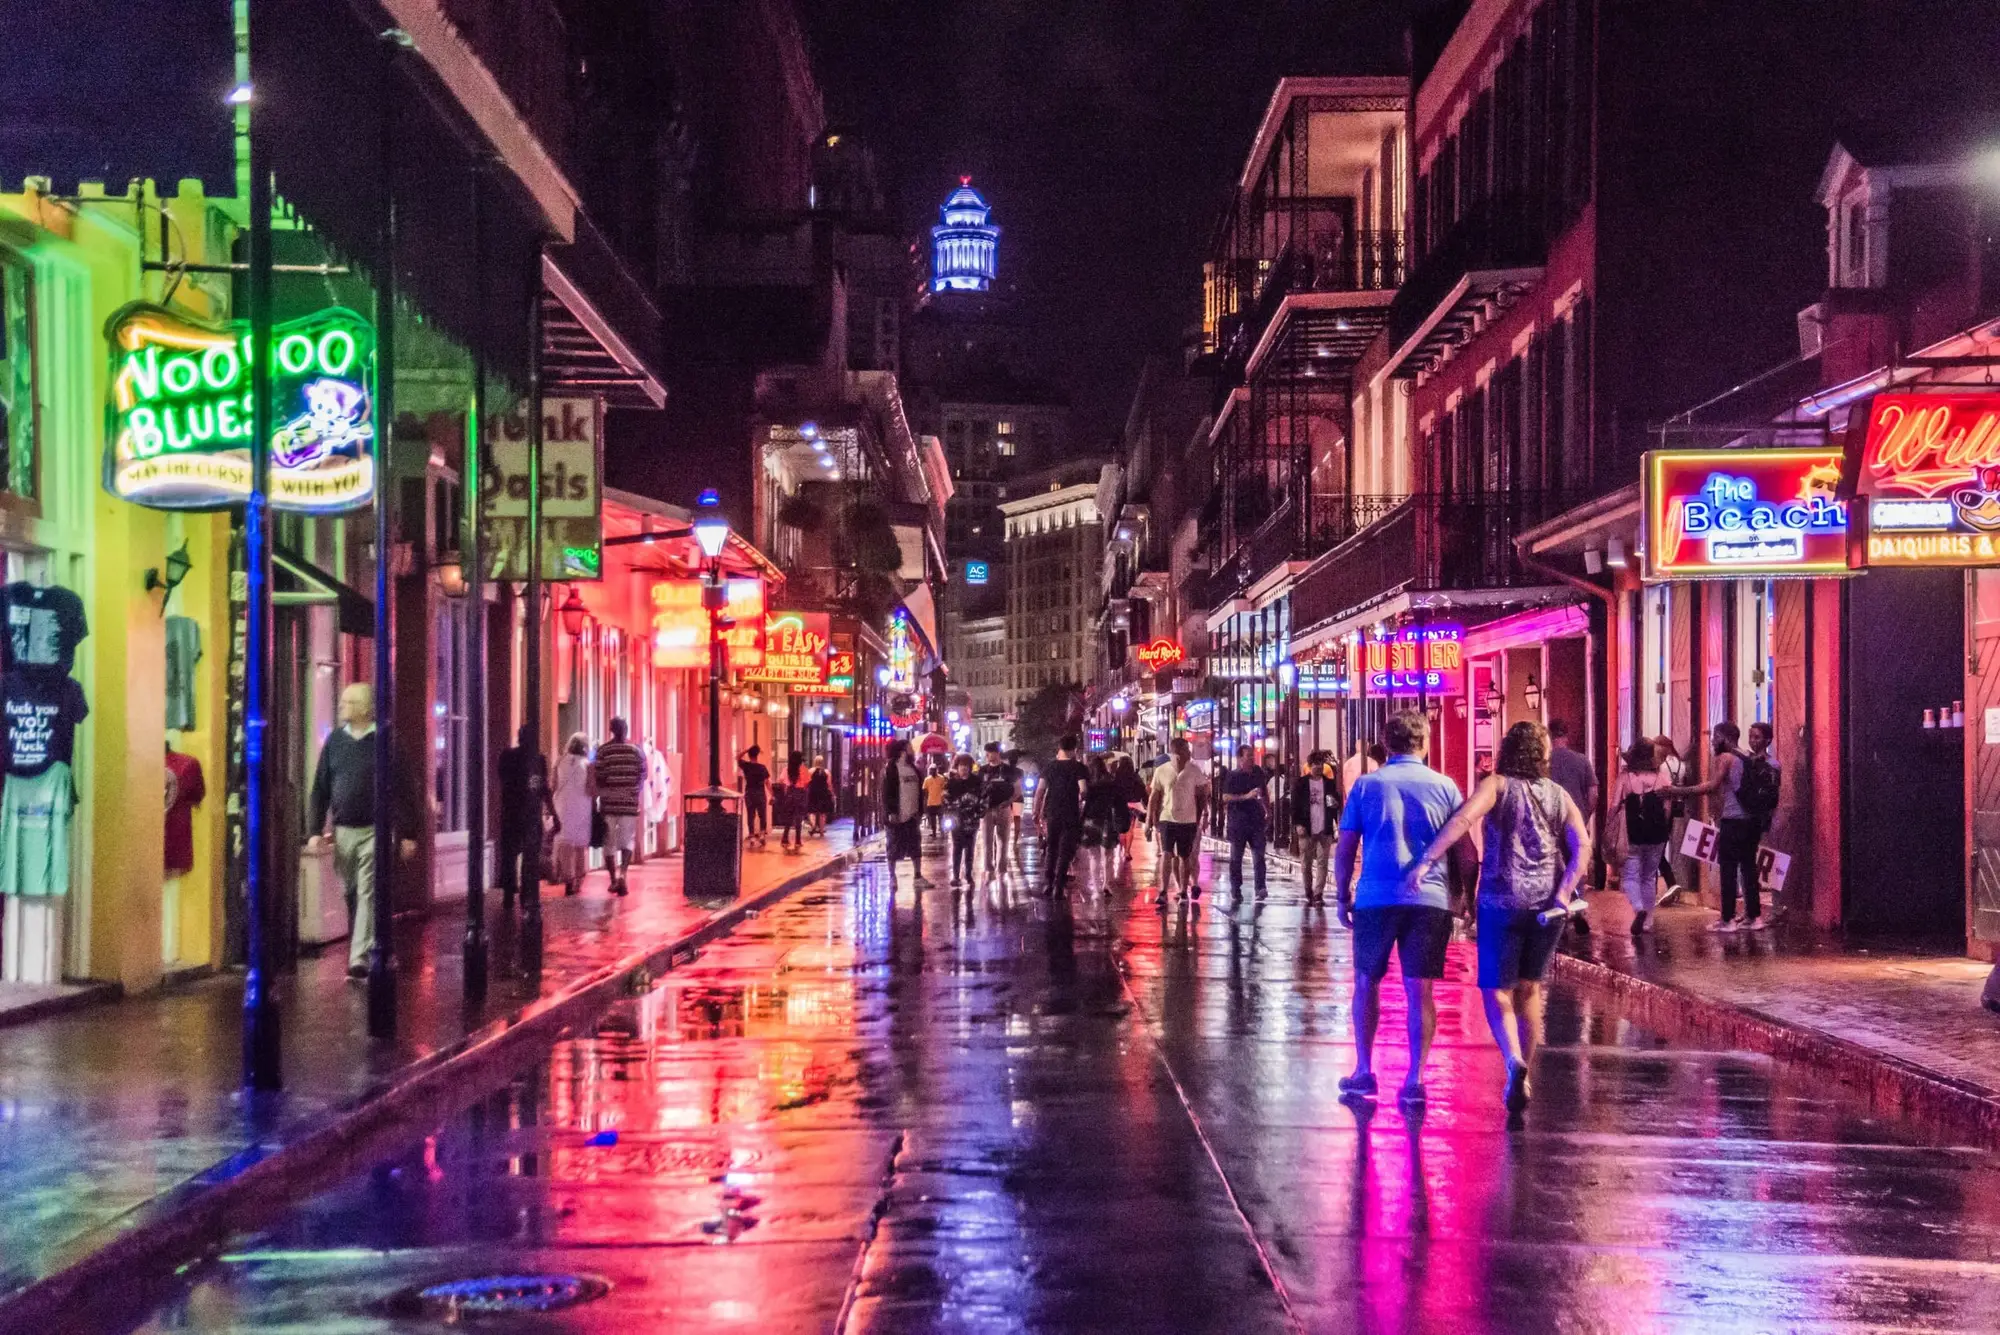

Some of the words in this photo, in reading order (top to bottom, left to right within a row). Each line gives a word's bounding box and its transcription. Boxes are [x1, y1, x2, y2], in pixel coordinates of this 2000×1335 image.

[129, 331, 354, 398] VOOOO
[1707, 477, 1753, 508] the
[1685, 497, 1847, 532] Beach
[1748, 533, 1760, 542] on
[1870, 536, 1972, 561] DAIQUIRIS
[1979, 534, 1996, 557] &
[969, 566, 985, 575] AC
[782, 627, 826, 654] EASY
[1139, 647, 1160, 660] Hard
[1160, 646, 1181, 661] Rock
[1351, 641, 1460, 672] HUSTER
[744, 667, 767, 679] PIZZA
[768, 668, 780, 679] BY
[782, 668, 797, 680] THE
[798, 669, 820, 681] SLICE
[6, 700, 33, 715] fuck
[34, 705, 60, 718] you
[17, 716, 48, 729] YOU
[15, 740, 46, 752] fuck
